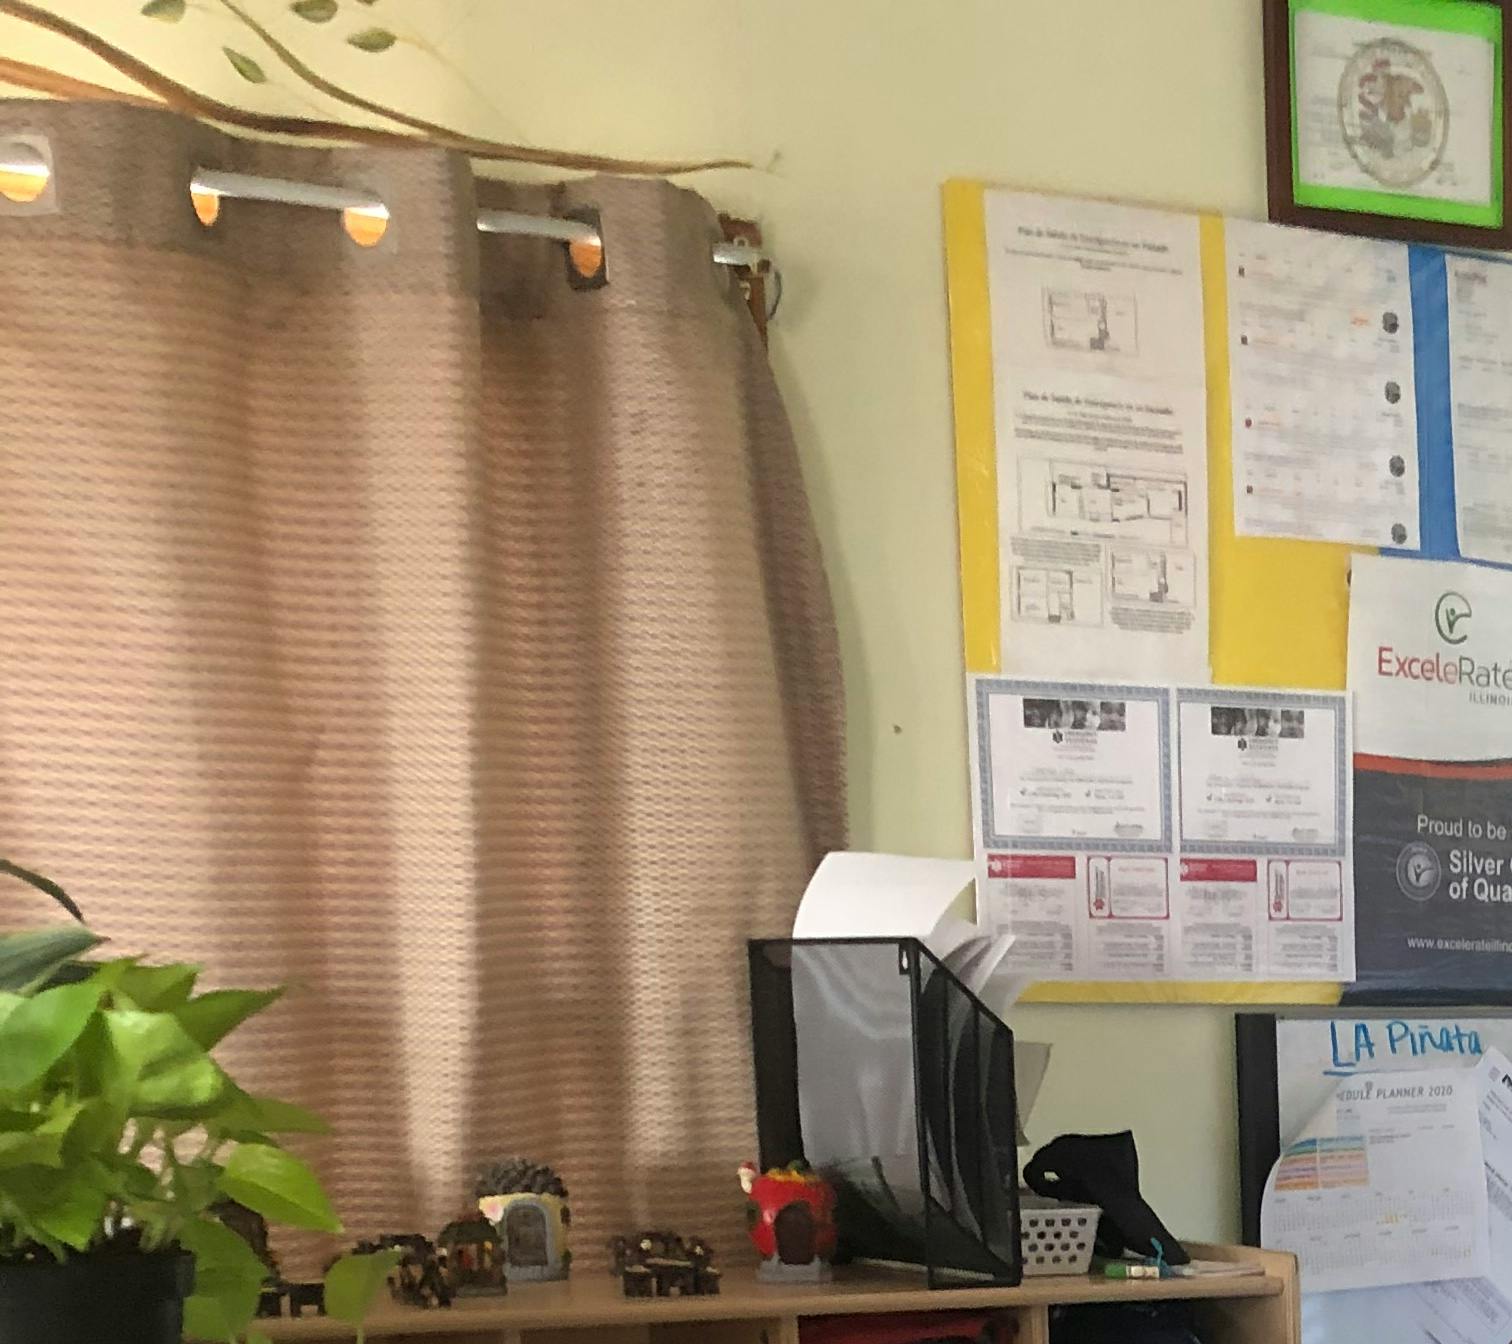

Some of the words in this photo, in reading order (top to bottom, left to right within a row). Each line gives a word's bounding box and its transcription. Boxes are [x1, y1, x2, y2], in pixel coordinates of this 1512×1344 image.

[1417, 814, 1464, 838] Proud
[1468, 820, 1483, 839] to
[1487, 821, 1508, 841] be
[1449, 849, 1504, 876] Silver
[1448, 877, 1469, 900] of
[1331, 1020, 1375, 1067] LA
[1376, 1086, 1425, 1099] PLANNER
[1428, 1085, 1454, 1097] 2020
